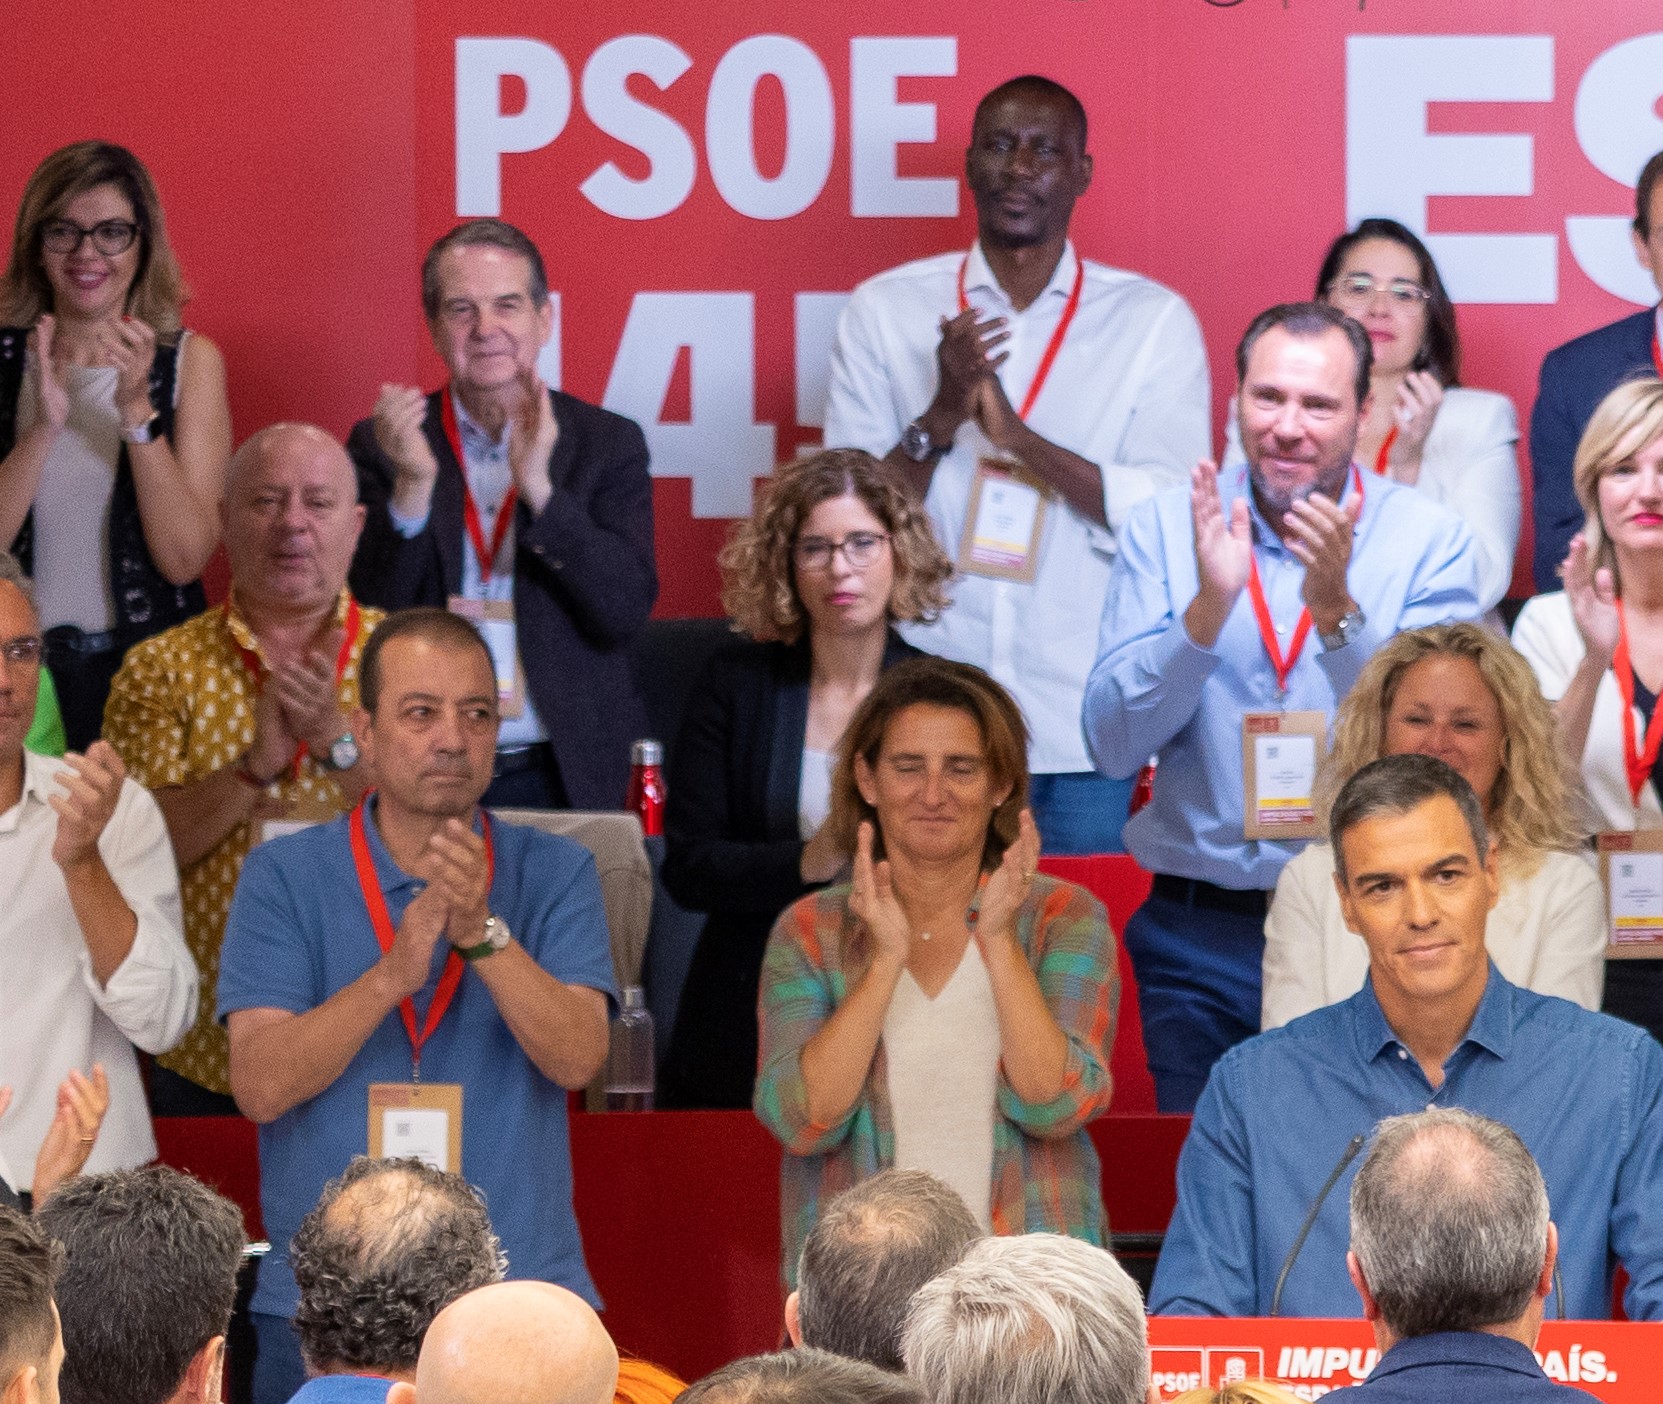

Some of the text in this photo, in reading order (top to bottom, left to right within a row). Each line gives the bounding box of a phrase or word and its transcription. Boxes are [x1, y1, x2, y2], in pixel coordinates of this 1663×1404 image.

[454, 35, 959, 220] PSOE
[1152, 1371, 1201, 1393] PSOE
[1277, 1343, 1618, 1383] IMPU AÍS.
